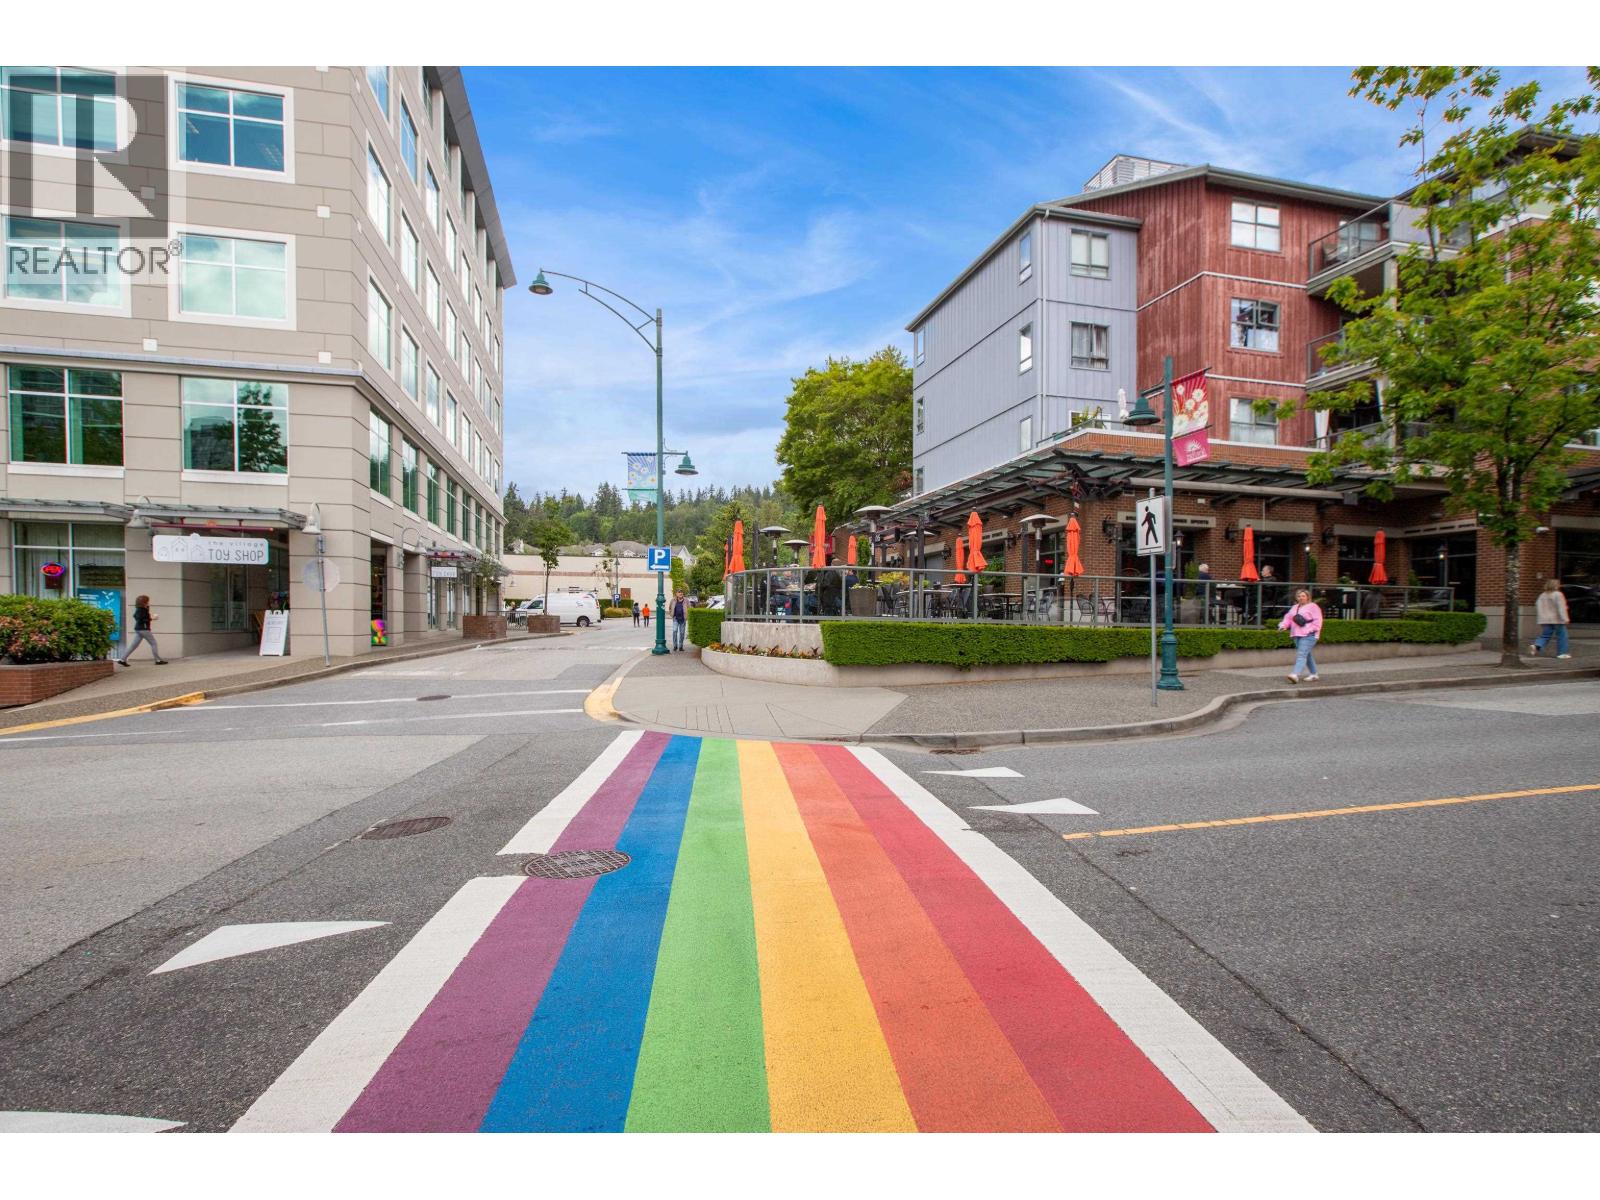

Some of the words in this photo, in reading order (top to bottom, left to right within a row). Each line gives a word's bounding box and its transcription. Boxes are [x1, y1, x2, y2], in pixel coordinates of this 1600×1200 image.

[208, 548, 230, 561] TOY
[235, 549, 264, 562] SHOP
[654, 549, 665, 564] P
